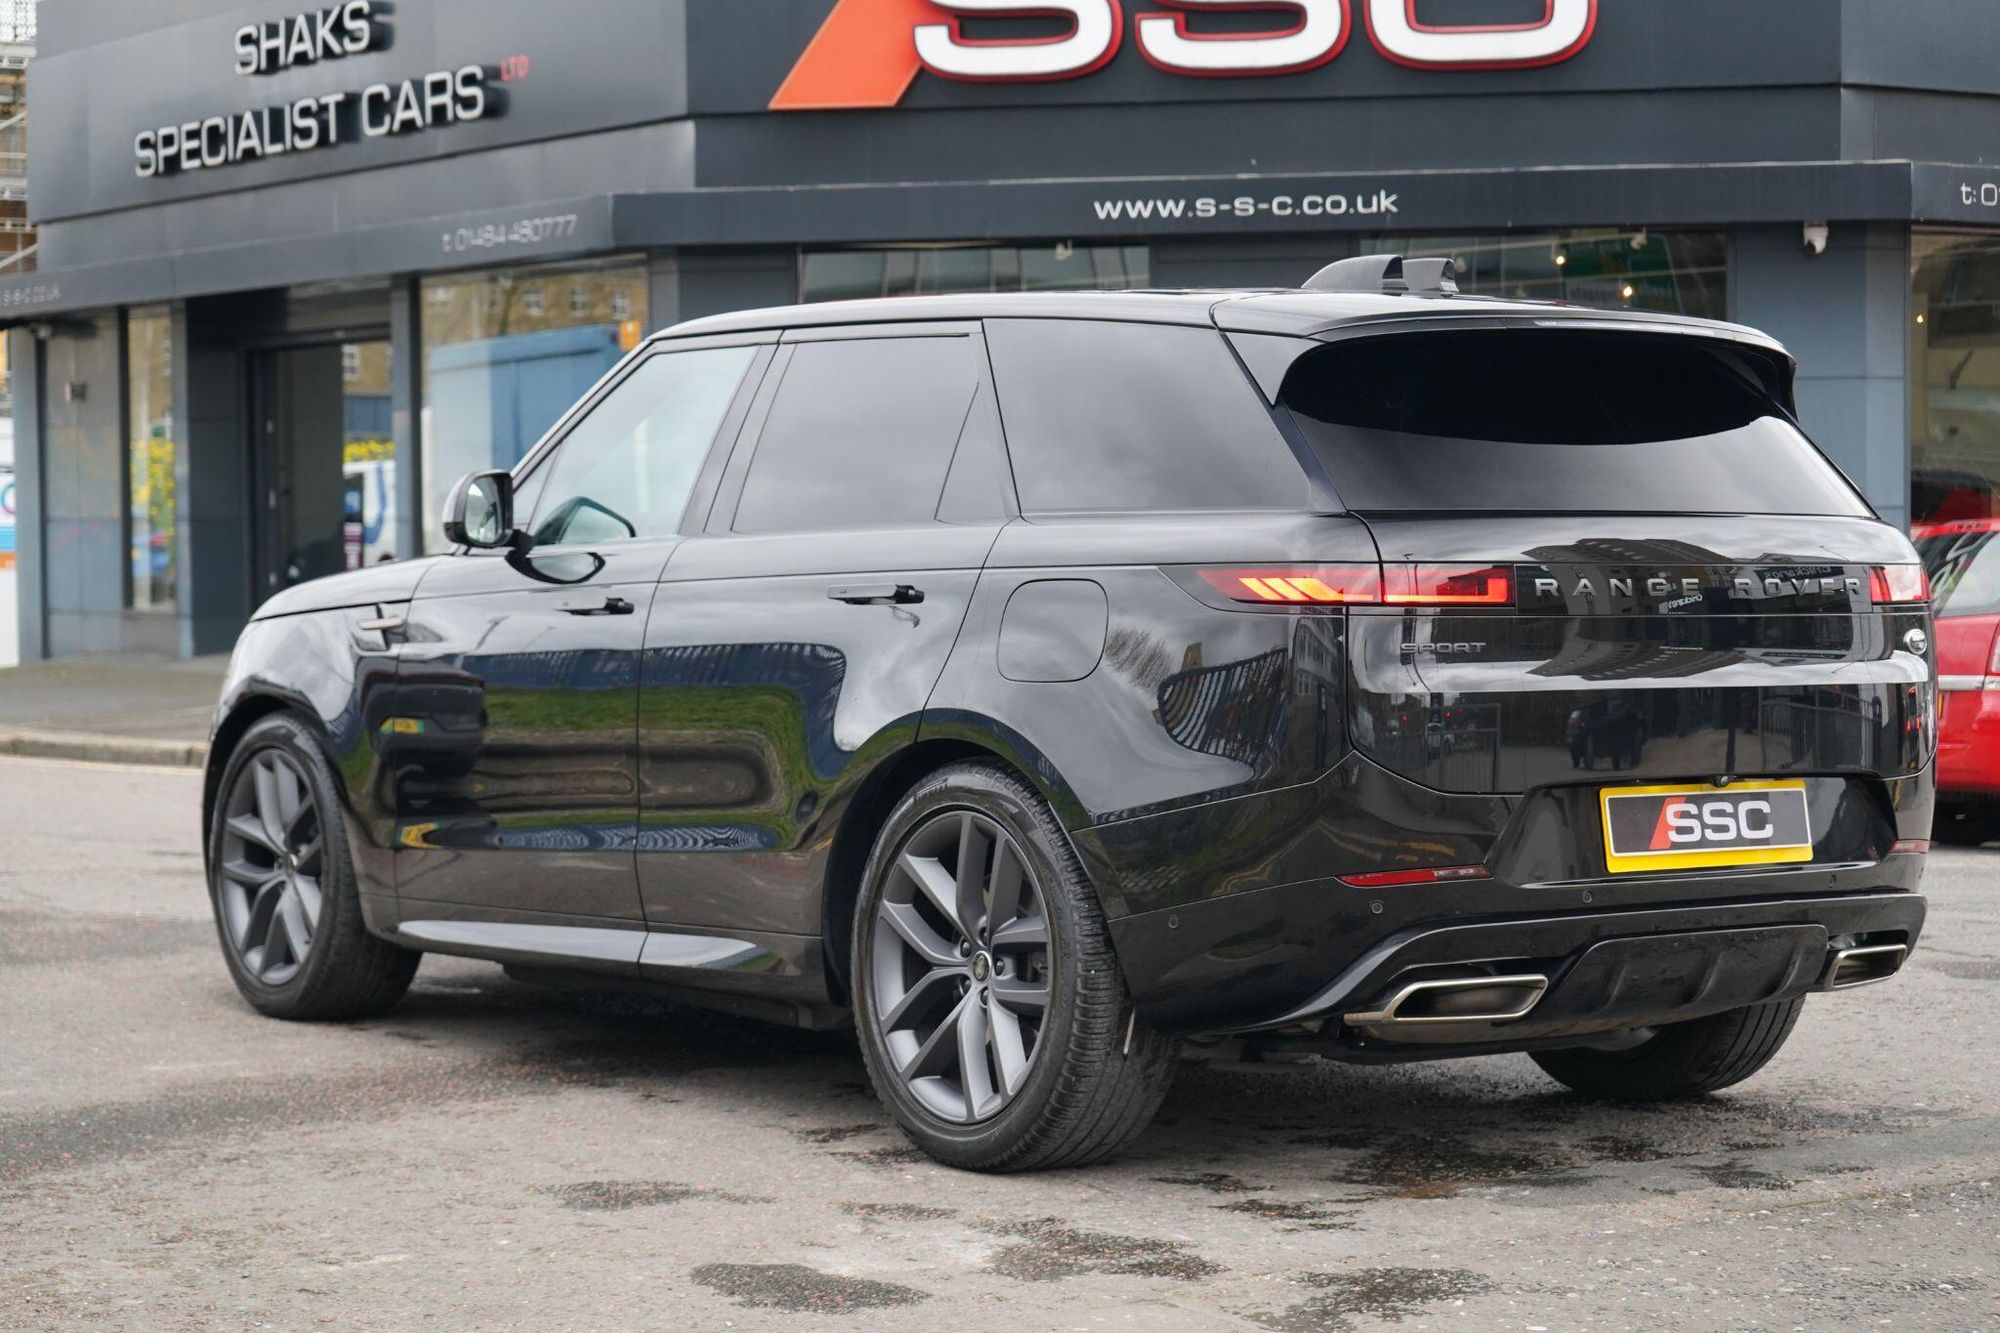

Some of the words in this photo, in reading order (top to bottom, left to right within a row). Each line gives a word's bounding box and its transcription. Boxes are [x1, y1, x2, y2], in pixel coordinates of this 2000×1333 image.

[234, 0, 371, 75] SHAKS
[134, 92, 346, 178] SPECIALIST
[361, 64, 485, 138] CARS
[500, 55, 530, 82] LTD
[1093, 189, 1399, 219] www.s-s-c.co.uk
[1534, 577, 1700, 597] RANGE
[1733, 577, 1861, 597] ROVER
[1400, 642, 1487, 654] SPORT
[1665, 800, 1774, 843] SSC
